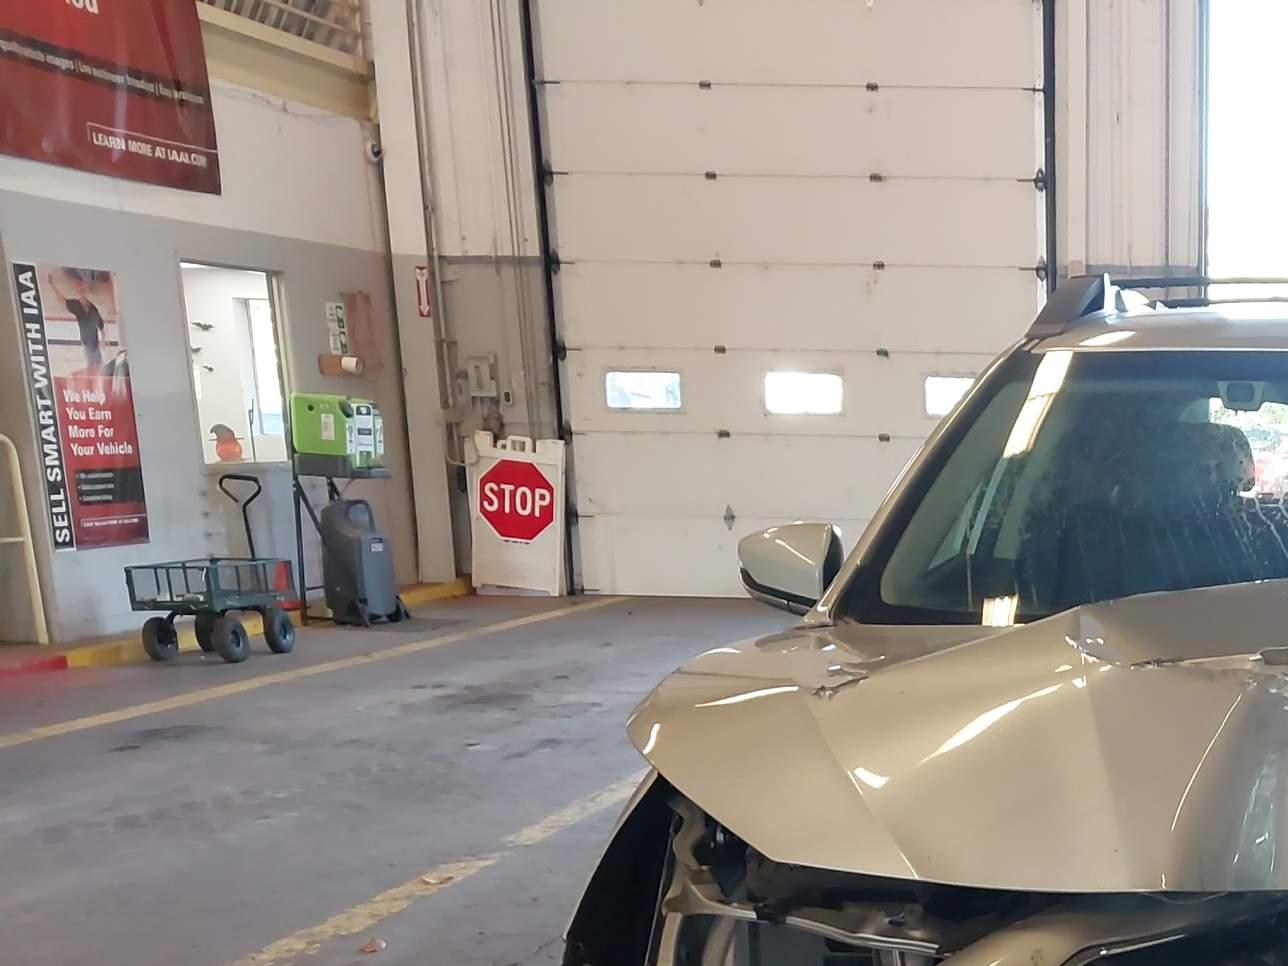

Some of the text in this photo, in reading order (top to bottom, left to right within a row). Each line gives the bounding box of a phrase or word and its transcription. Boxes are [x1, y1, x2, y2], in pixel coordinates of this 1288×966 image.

[92, 131, 126, 150] LEARN
[127, 140, 153, 157] MORE
[154, 146, 166, 159] AT
[63, 389, 106, 406] We Help
[18, 271, 71, 543] SELL SMART WITH IAA
[65, 407, 112, 420] You Earn
[67, 424, 114, 439] More For
[70, 441, 133, 456] Your Vehicle
[482, 482, 551, 518] STOP
